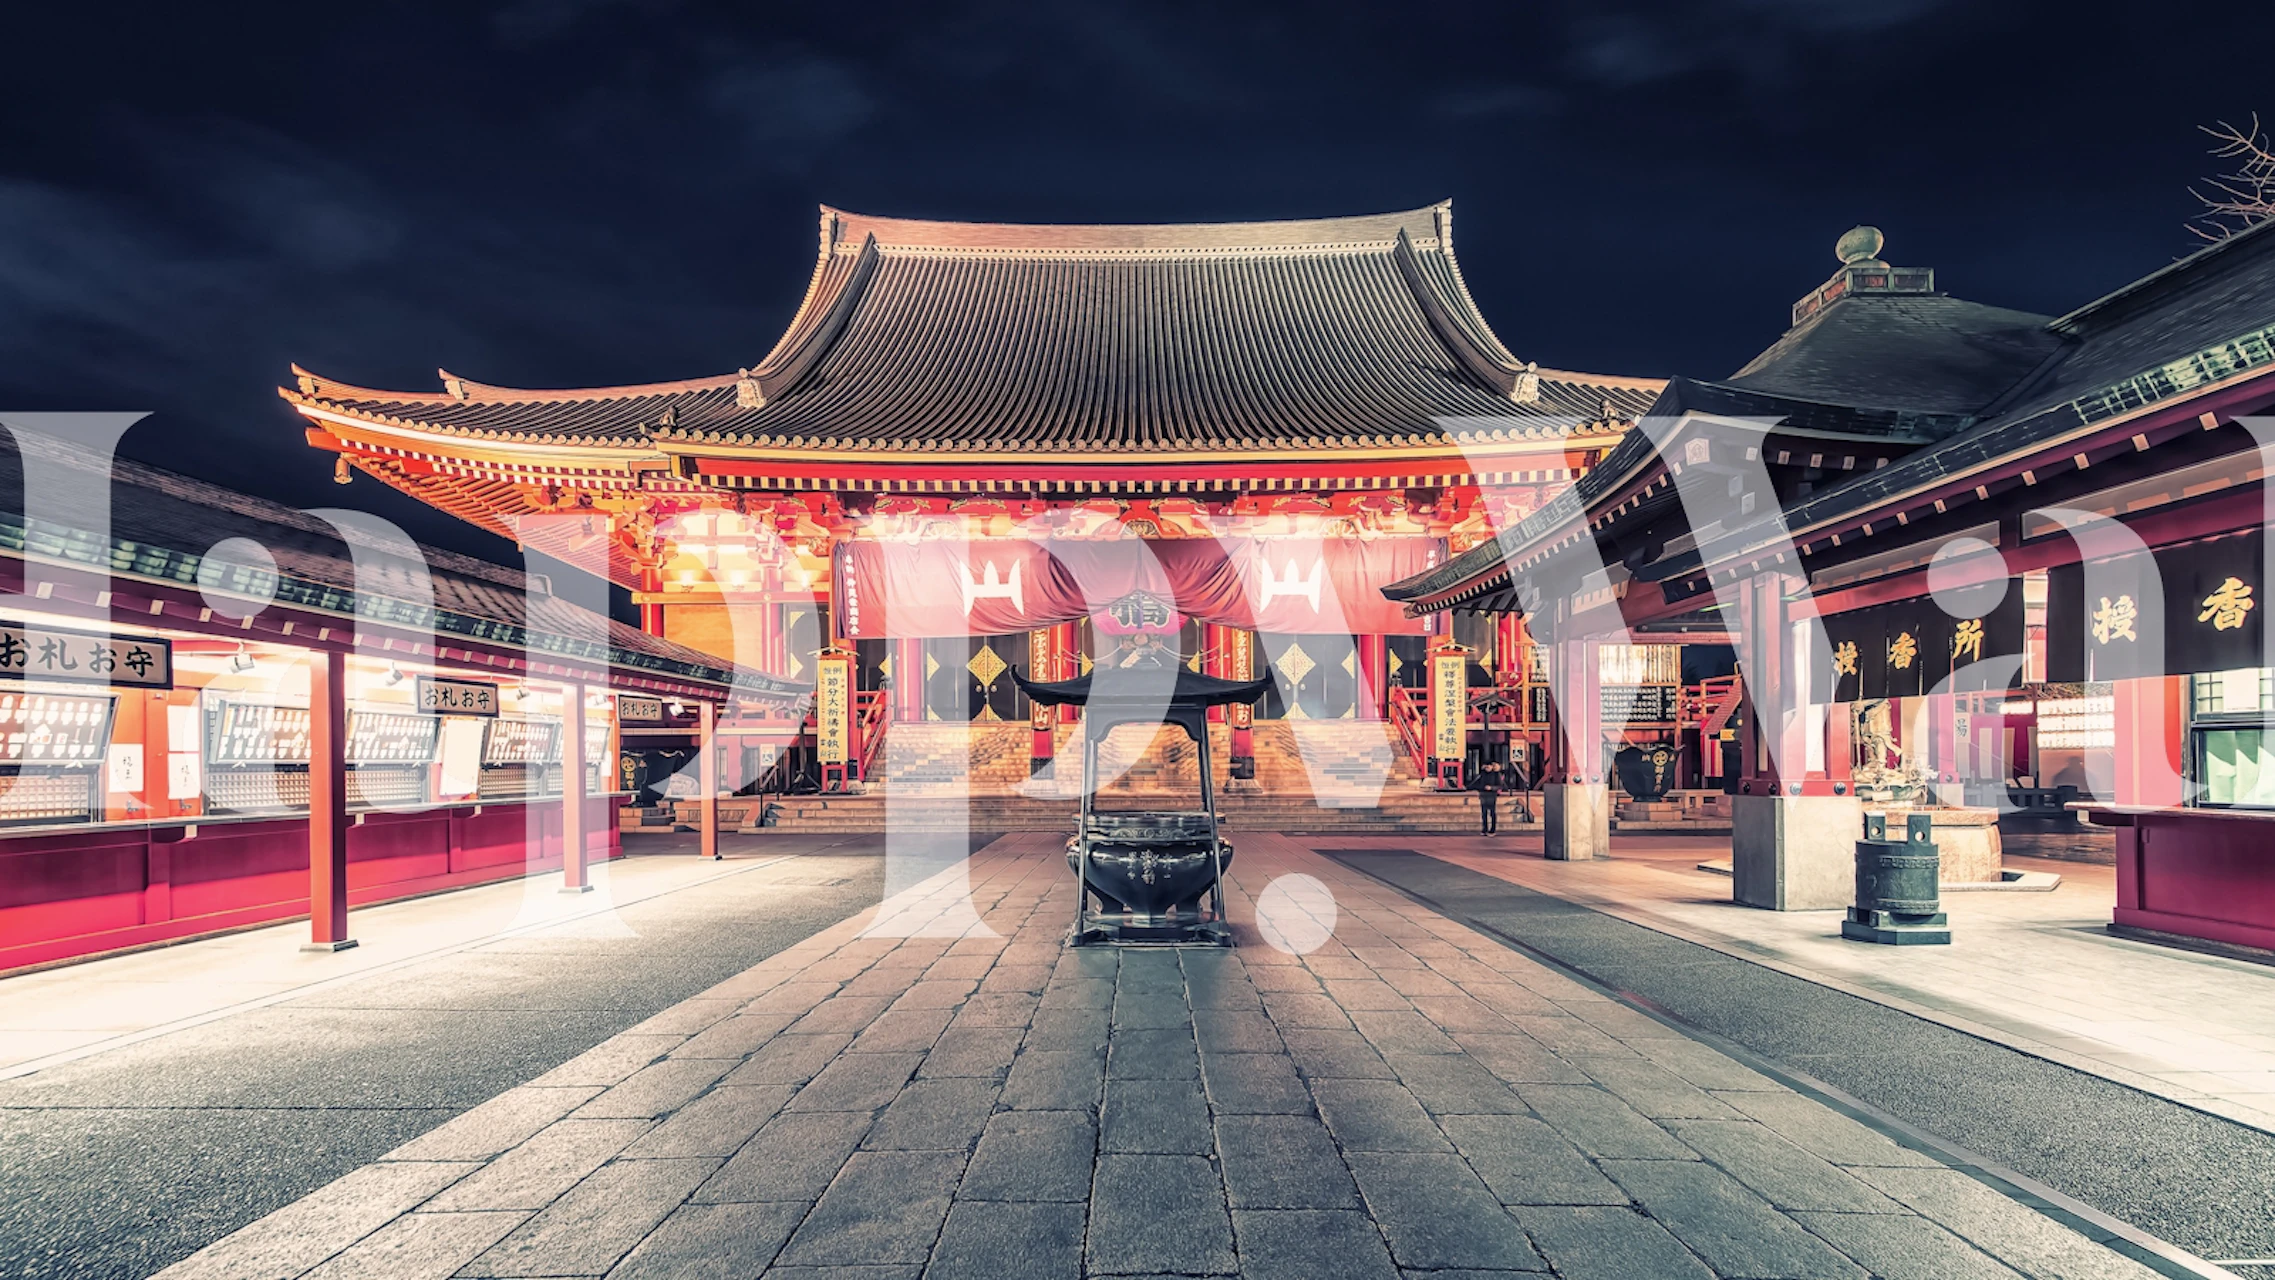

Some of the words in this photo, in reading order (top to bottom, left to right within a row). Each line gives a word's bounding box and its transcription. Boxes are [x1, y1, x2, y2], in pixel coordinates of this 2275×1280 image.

[0, 632, 154, 678] お札お守
[425, 684, 491, 712] お札お守
[621, 700, 658, 719] お札お守
